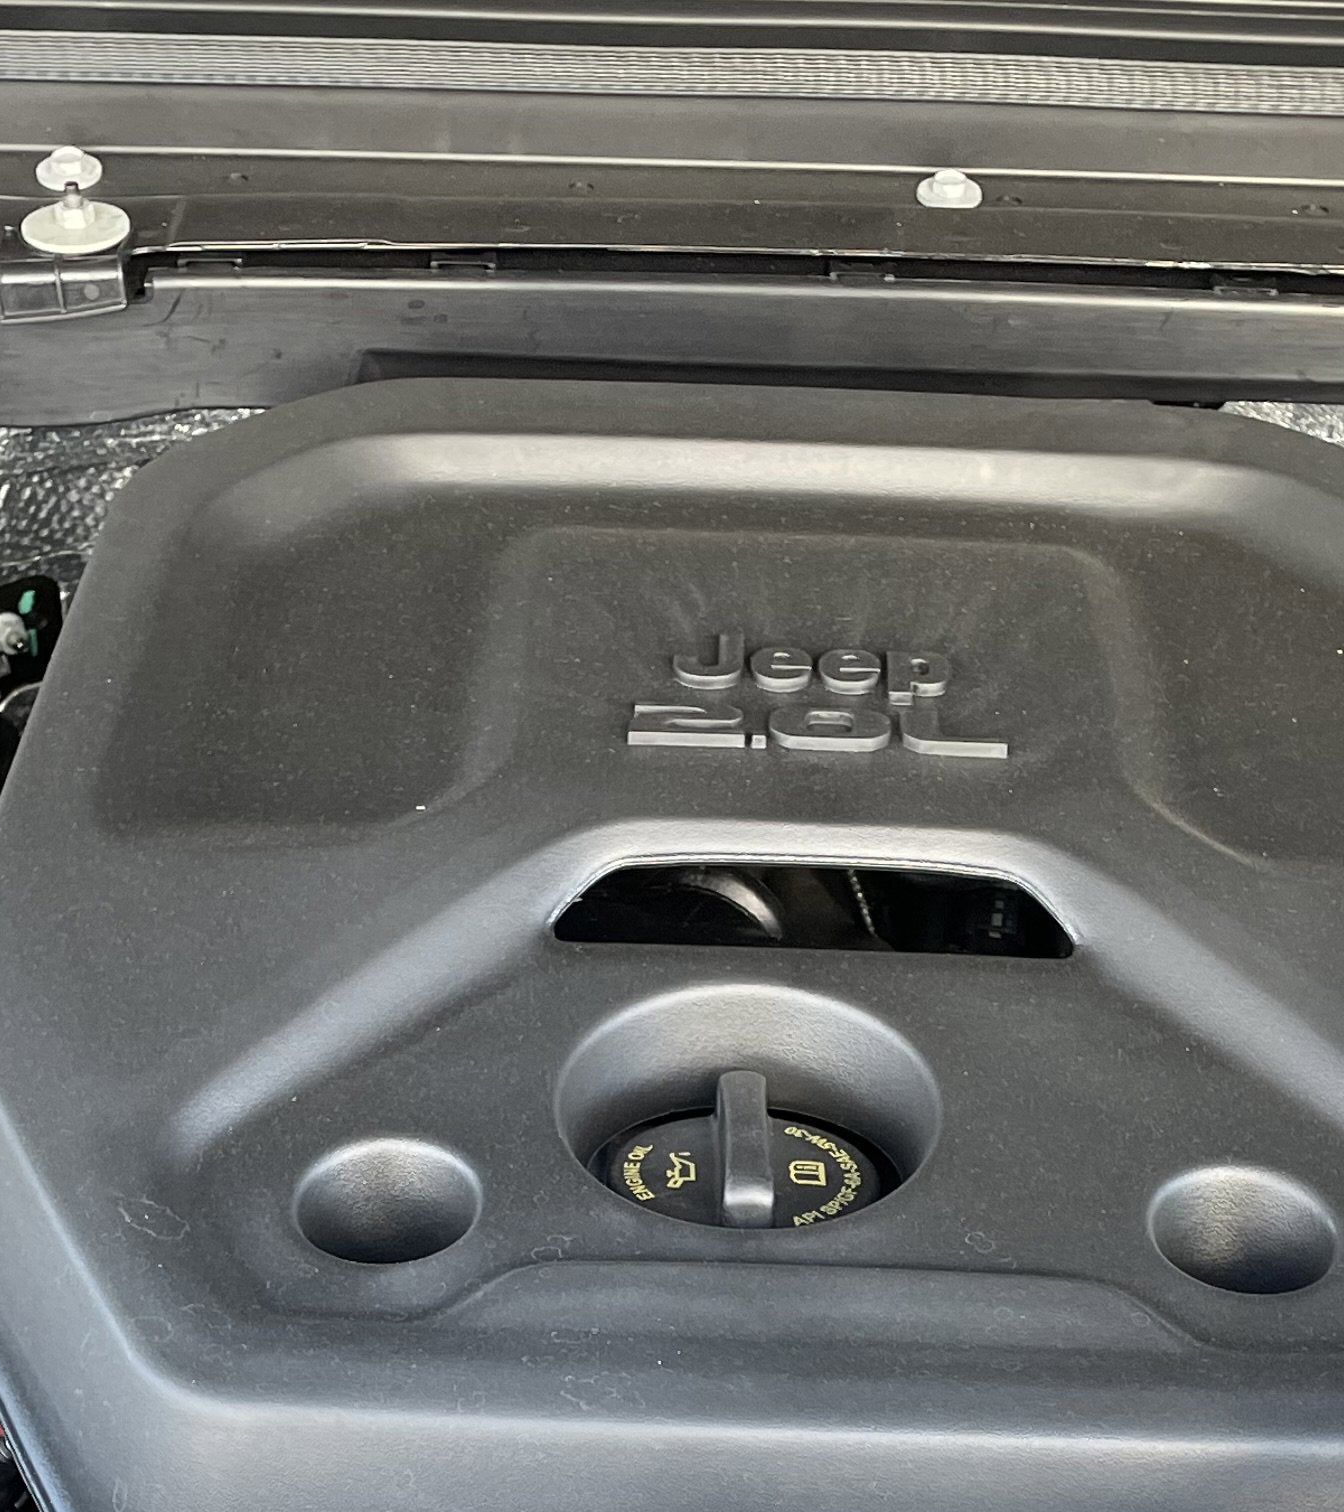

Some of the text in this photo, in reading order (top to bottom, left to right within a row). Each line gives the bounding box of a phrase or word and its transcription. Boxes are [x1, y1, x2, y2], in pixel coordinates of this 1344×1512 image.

[672, 631, 952, 706] Jeep
[626, 702, 1010, 759] 2.0L
[623, 1144, 656, 1201] ENGINE OIL
[792, 1210, 826, 1227] API
